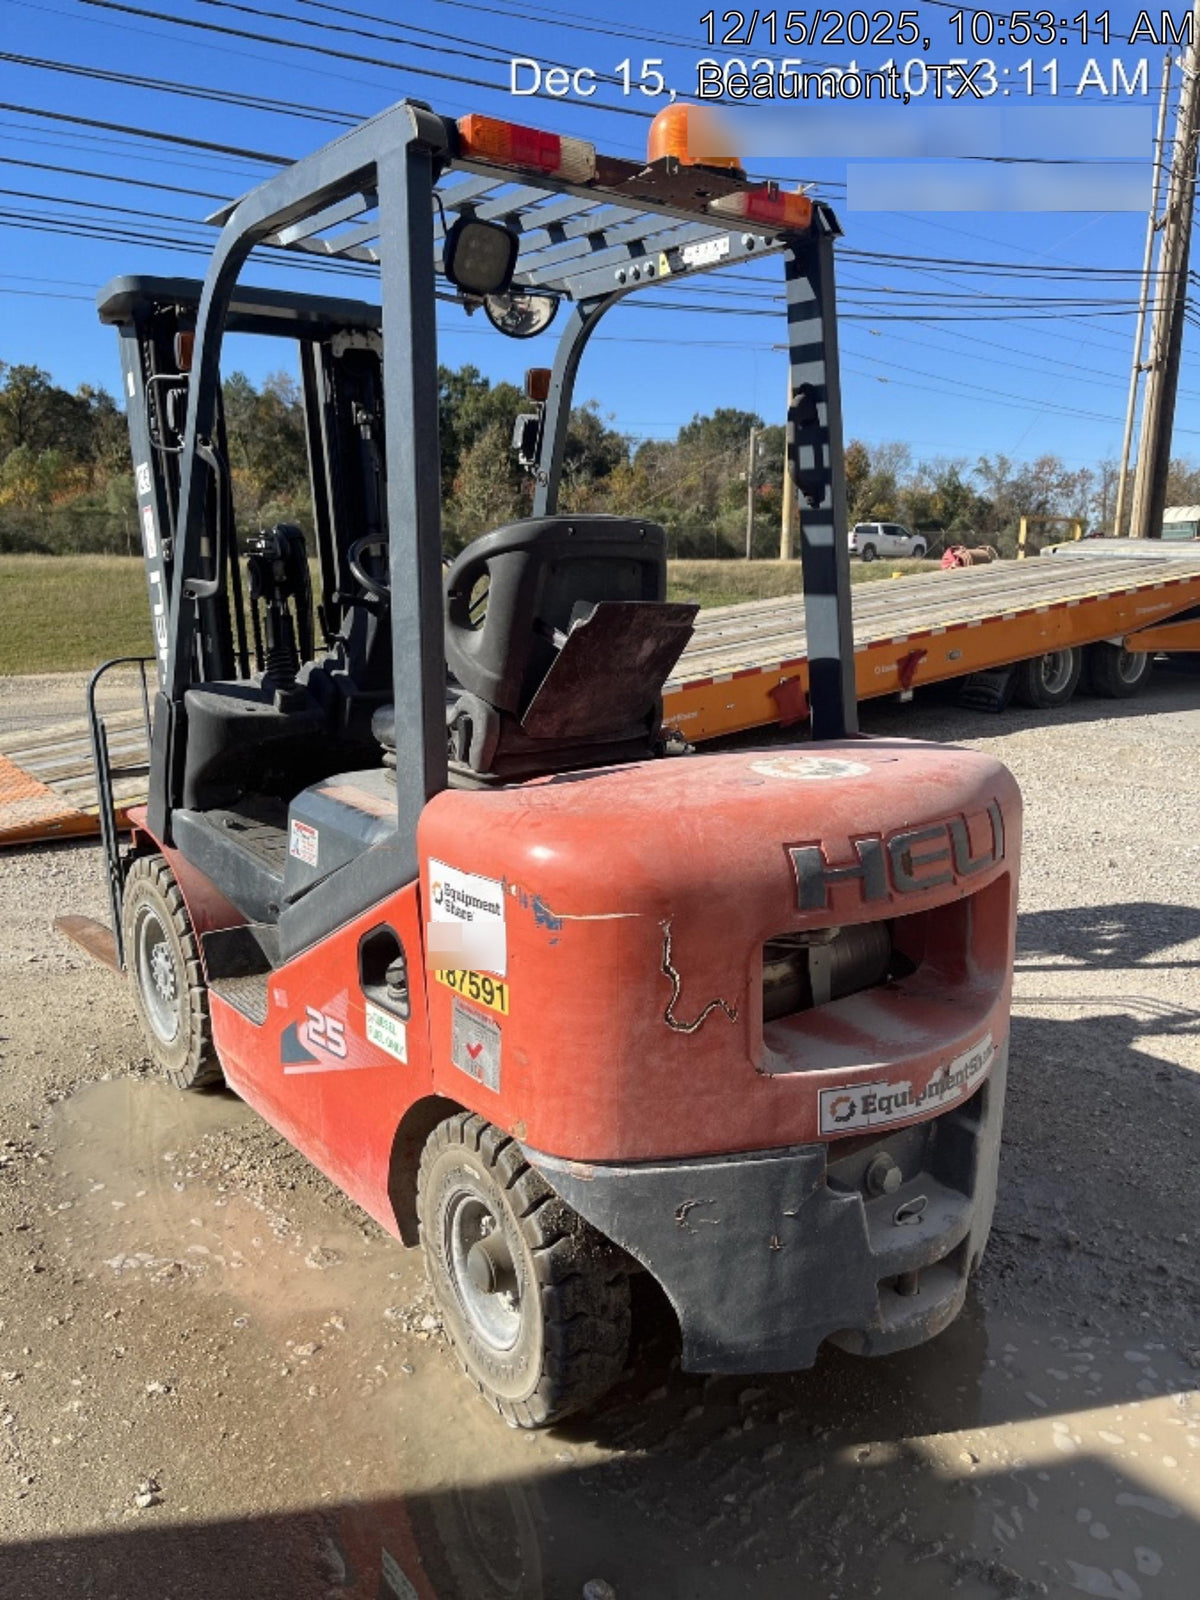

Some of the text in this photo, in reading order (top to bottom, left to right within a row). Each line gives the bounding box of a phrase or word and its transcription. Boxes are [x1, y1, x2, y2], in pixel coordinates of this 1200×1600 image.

[785, 798, 1005, 911] HELI
[443, 881, 502, 917] Equipment
[305, 1004, 348, 1060] 25
